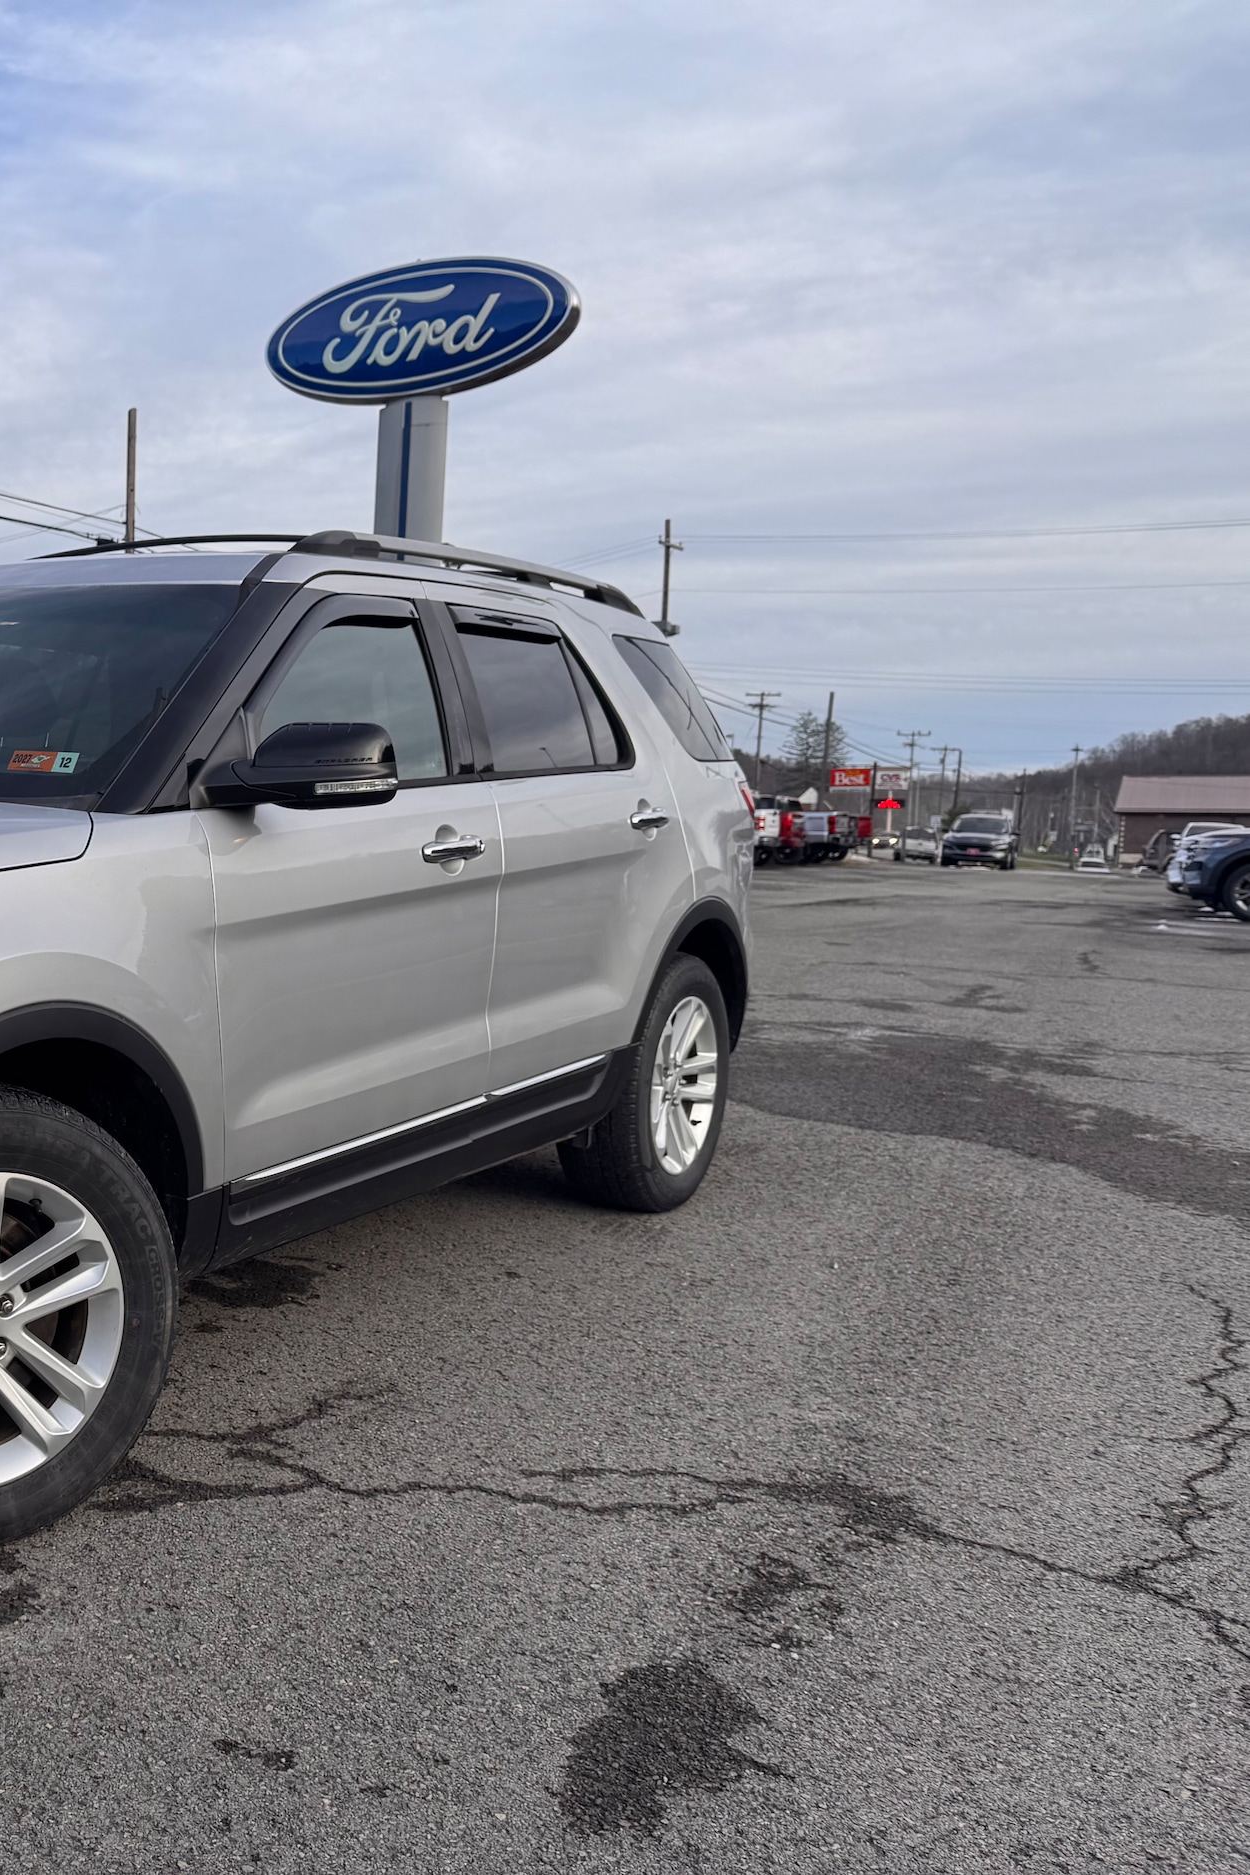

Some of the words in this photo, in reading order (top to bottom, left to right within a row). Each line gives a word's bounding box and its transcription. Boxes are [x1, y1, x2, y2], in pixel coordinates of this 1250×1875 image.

[322, 284, 501, 374] Ford
[58, 756, 73, 769] 12
[834, 771, 866, 786] Best
